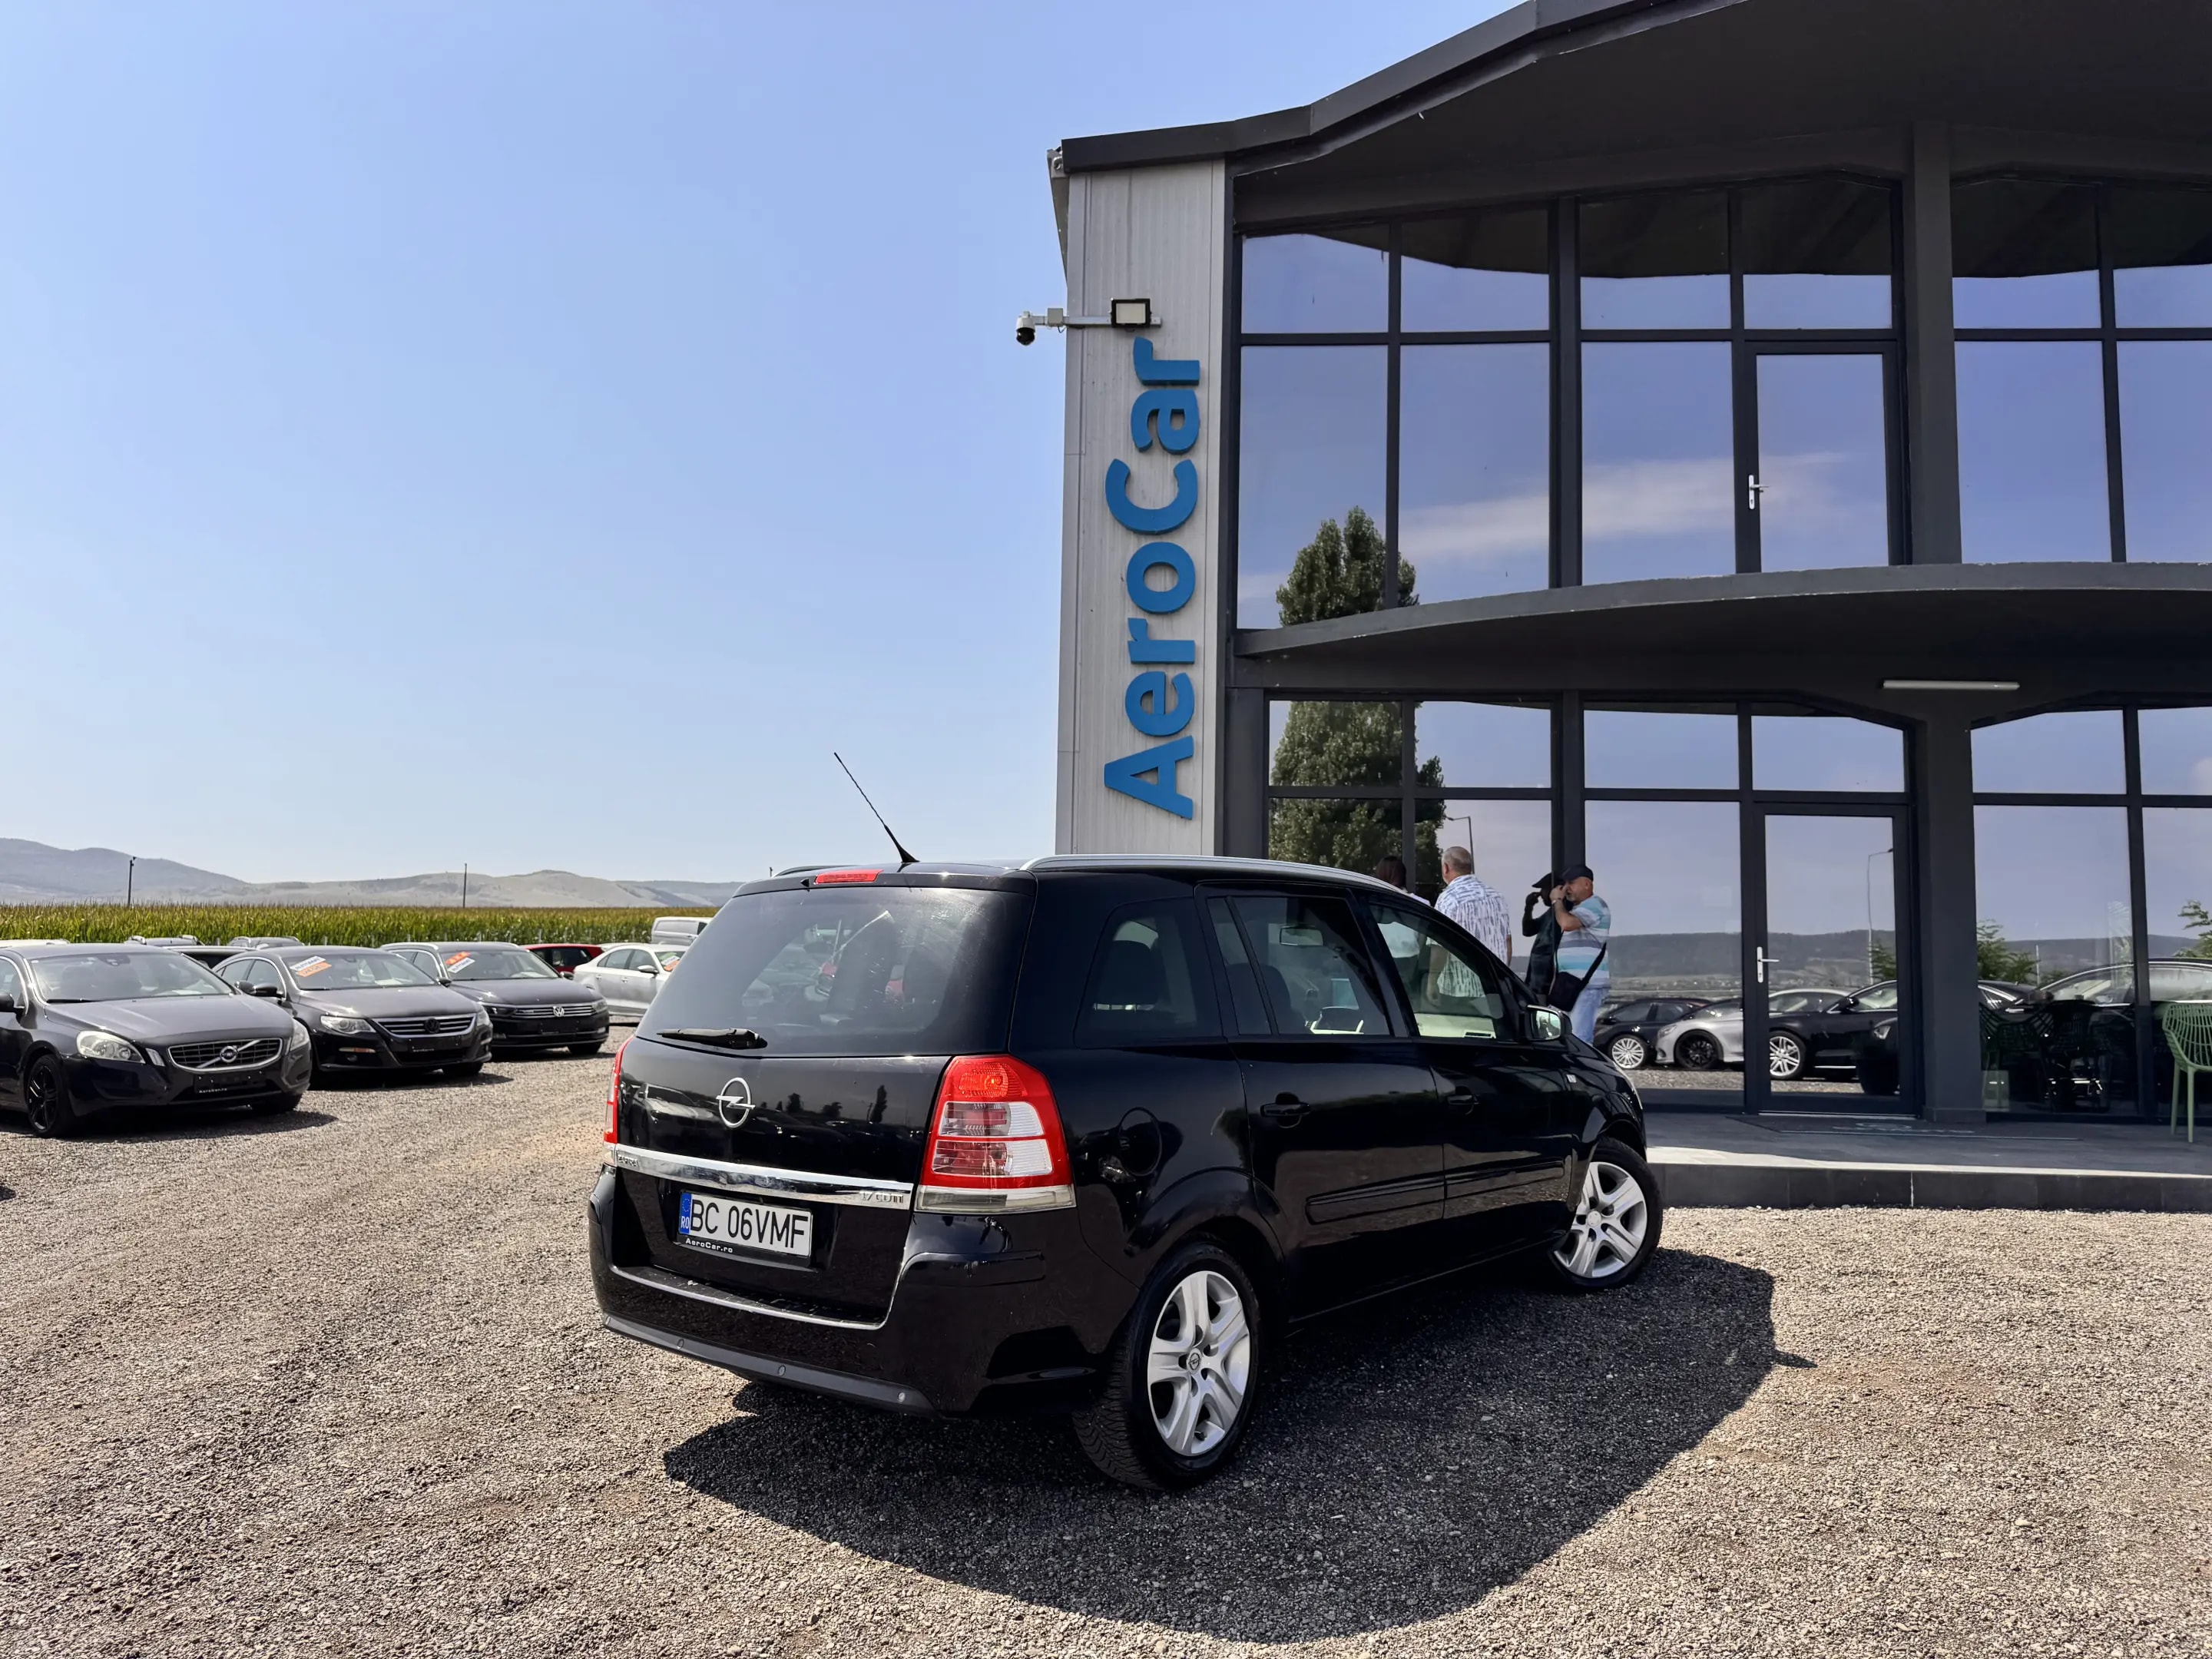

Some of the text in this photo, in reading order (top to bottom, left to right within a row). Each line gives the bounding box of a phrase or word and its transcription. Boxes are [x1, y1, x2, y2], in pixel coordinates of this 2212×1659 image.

[1104, 336, 1201, 820] AeroCar
[680, 1216, 690, 1229] RO
[690, 1199, 809, 1249] BC 06VMF
[685, 1237, 733, 1253] AeroCar.ro
